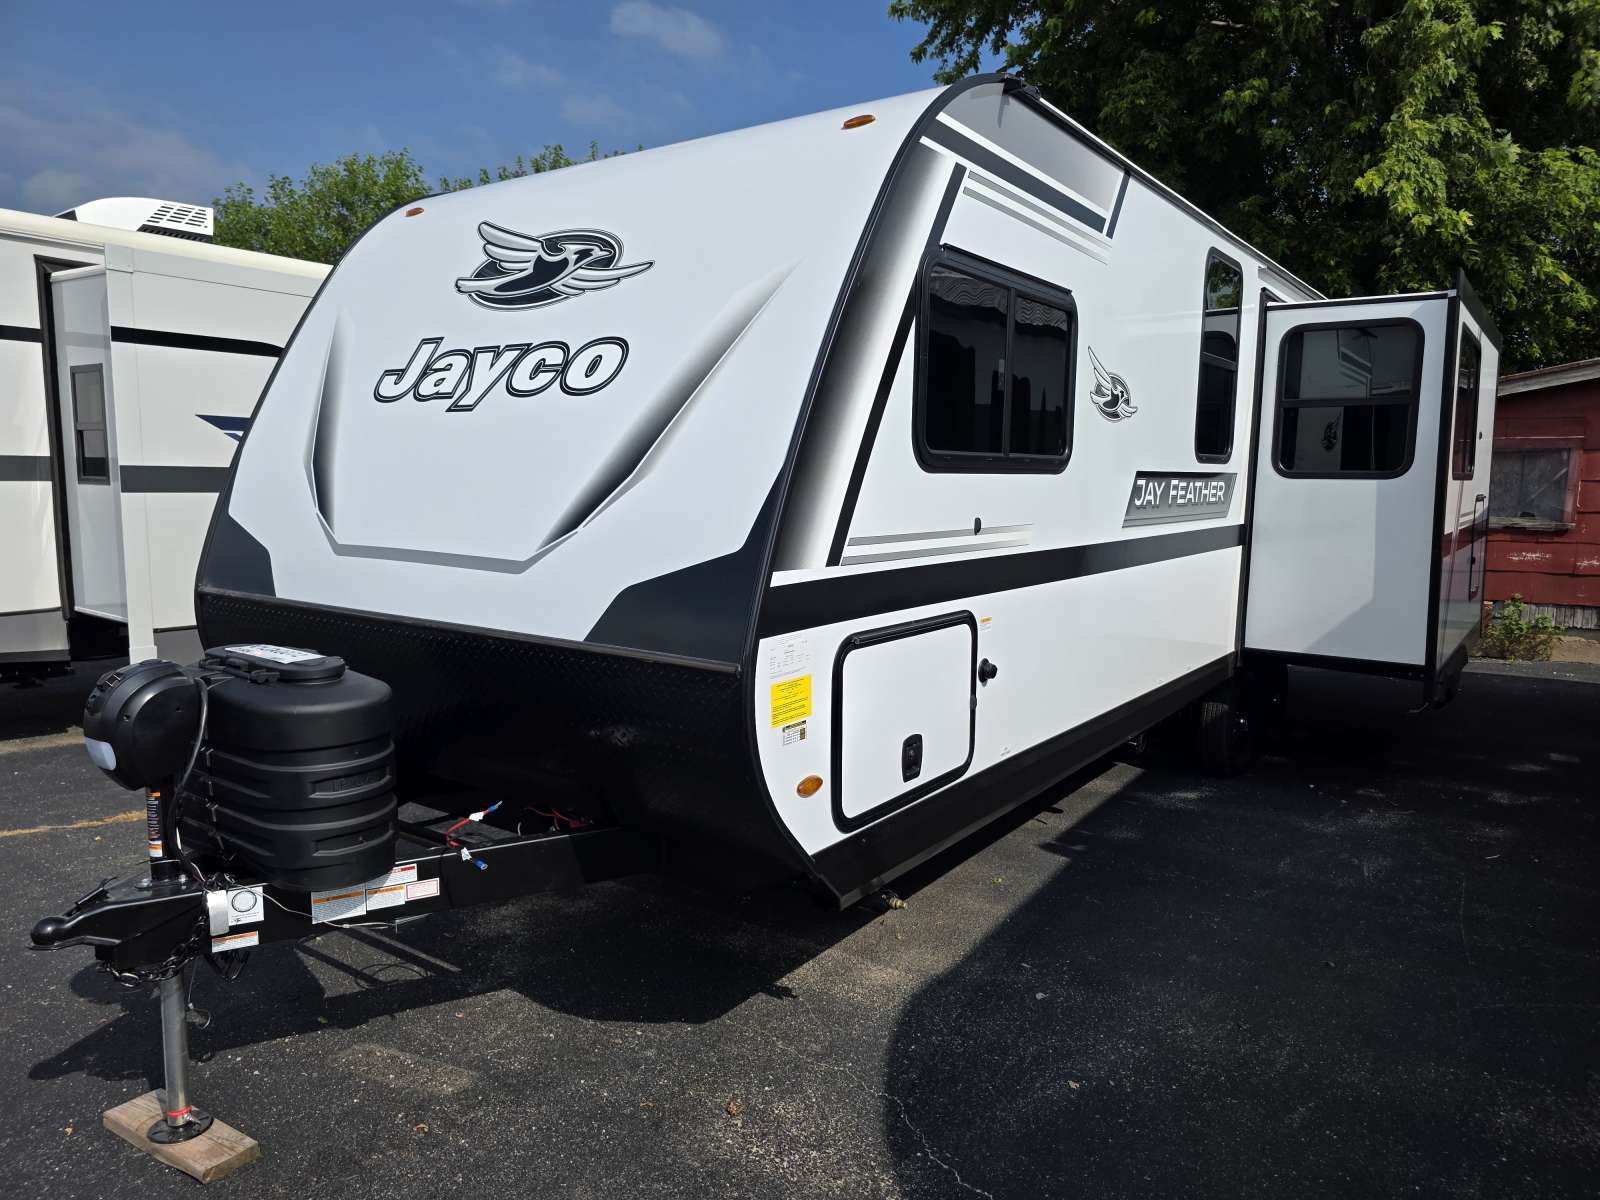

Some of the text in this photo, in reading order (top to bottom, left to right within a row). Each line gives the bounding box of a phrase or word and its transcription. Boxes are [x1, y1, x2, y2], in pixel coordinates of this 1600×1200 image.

[374, 336, 630, 412] Jayco
[1134, 479, 1225, 506] JAY FEATHER
